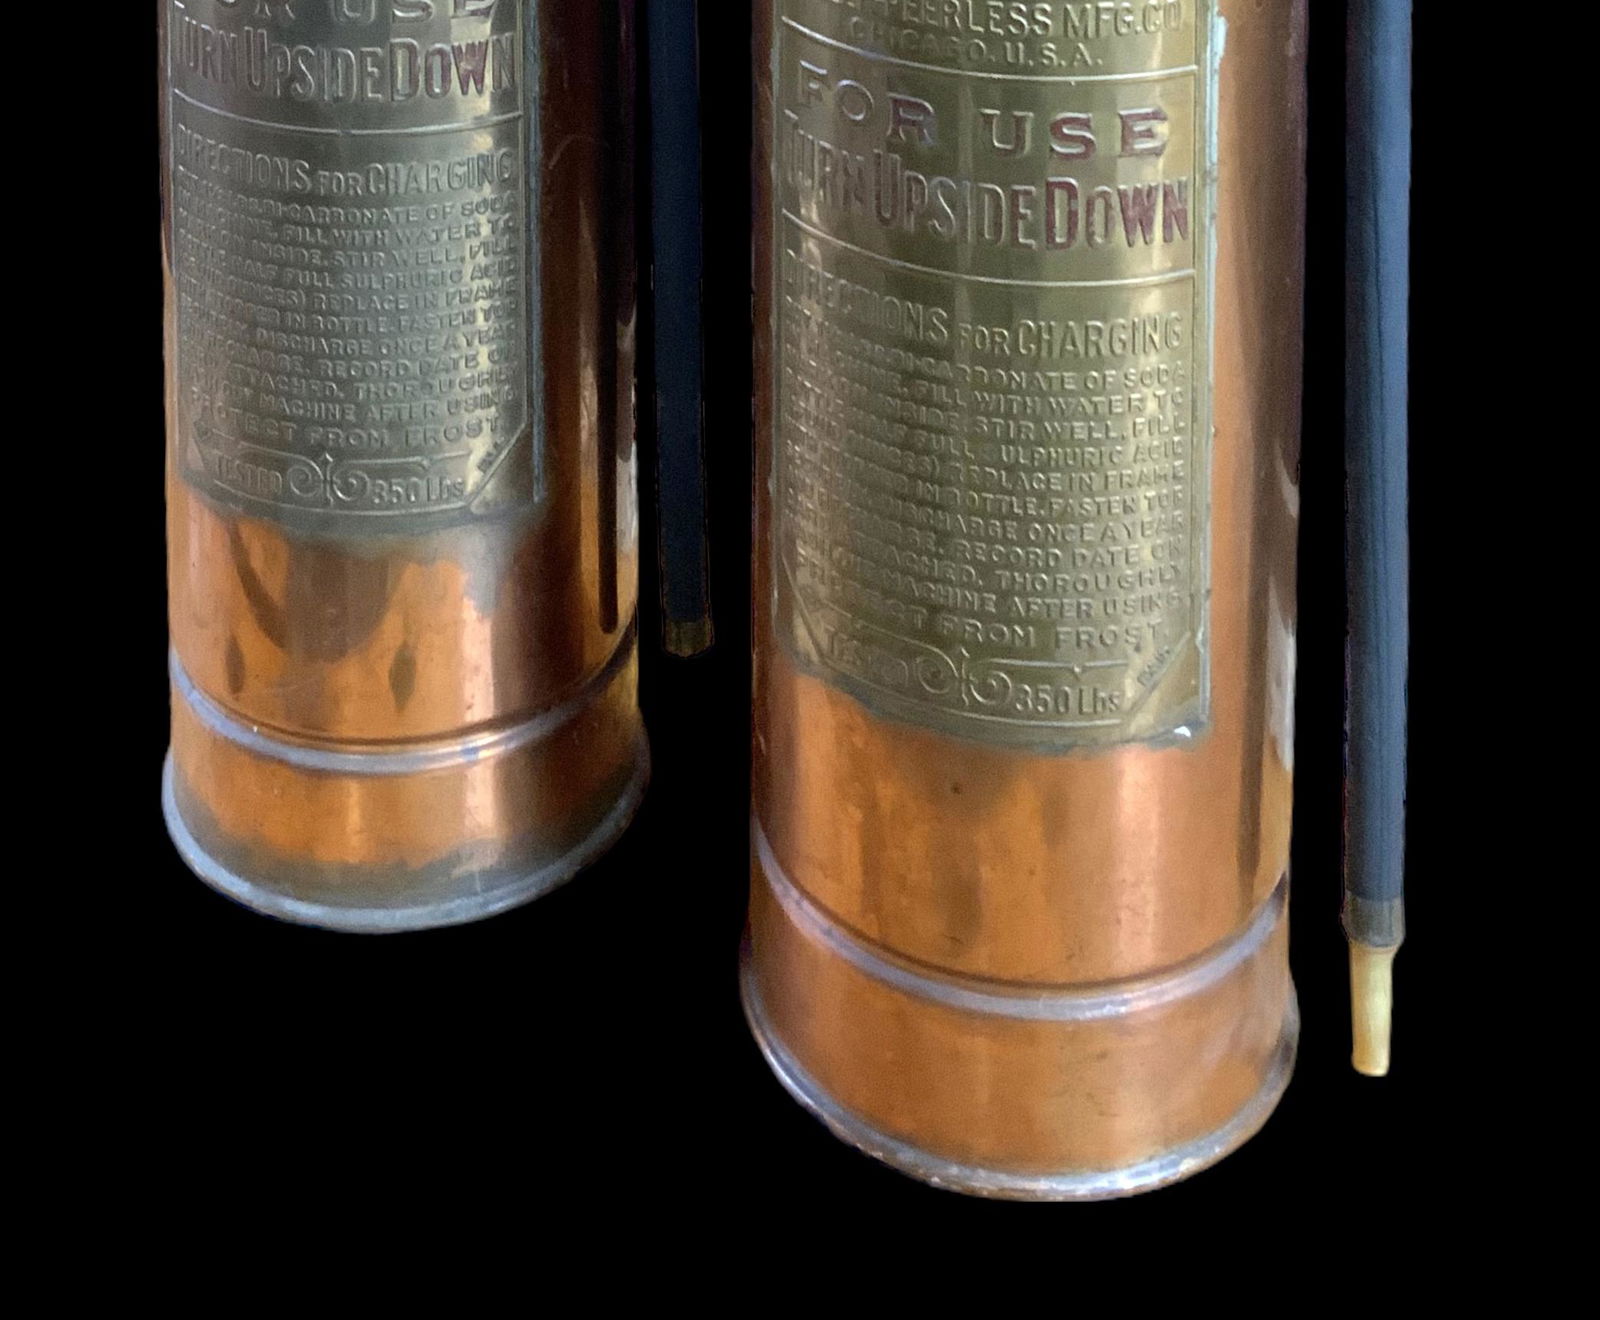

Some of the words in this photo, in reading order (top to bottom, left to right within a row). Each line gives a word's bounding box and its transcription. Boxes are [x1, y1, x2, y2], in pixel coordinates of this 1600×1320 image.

[174, 0, 239, 80] TURN
[245, 26, 384, 103] UPSIDE
[390, 32, 515, 102] DOWN
[1005, 40, 1103, 67] U.S.A.
[800, 59, 936, 146] FOR
[979, 105, 1171, 161] USE
[318, 169, 362, 196] FOR
[367, 147, 514, 196] CHARGING
[426, 203, 455, 221] OF
[873, 150, 1038, 251] UPSIDE
[1045, 176, 1189, 251] DOWN
[283, 224, 328, 245] FILL
[333, 227, 387, 247] WITH
[395, 221, 481, 245] WATER
[285, 267, 335, 288] FULL
[340, 268, 464, 291] SULPHURIC
[470, 255, 517, 281] ACID
[333, 250, 385, 268] STIR
[314, 291, 409, 311] REPLACE
[415, 291, 439, 310] IN
[446, 276, 517, 307] FRAME
[285, 311, 305, 330] IN
[400, 308, 477, 331] FASTEN
[957, 322, 1011, 358] FOR
[1017, 311, 1183, 358] CHARGING
[256, 327, 373, 356] DISCHARGE
[379, 335, 438, 356] ONCE
[443, 332, 460, 352] A
[319, 359, 411, 379] RECORD
[418, 352, 479, 376] DATE
[1084, 369, 1117, 391] OF
[1124, 360, 1186, 388] SODA
[259, 391, 356, 423] MACHINE
[366, 399, 440, 423] AFTER
[447, 383, 516, 416] USING
[915, 380, 967, 408] FILL
[974, 390, 1041, 415] WITH
[1050, 393, 1145, 415] WATER
[1153, 386, 1185, 409] TO
[305, 426, 389, 448] FROM
[975, 415, 1035, 440] STIR
[1132, 411, 1187, 438] FILL
[988, 442, 1124, 468] ULPHURIC
[1132, 435, 1184, 464] ACID
[373, 477, 421, 505] 350
[949, 461, 1062, 491] REPLACE
[1068, 471, 1099, 493] IN
[1104, 459, 1185, 488] FRAME
[1049, 495, 1138, 517] FASTEN
[1028, 522, 1096, 543] ONCE
[1121, 510, 1184, 540] YEAR
[954, 538, 1062, 568] RECORD
[1072, 544, 1140, 568] DATE
[994, 560, 1182, 593] THOROUGHLY
[1012, 595, 1094, 617] AFTER
[1103, 585, 1182, 616] USING
[938, 612, 1036, 647] FROM
[1015, 683, 1073, 714] 350
[1078, 686, 1122, 715] Lbs
